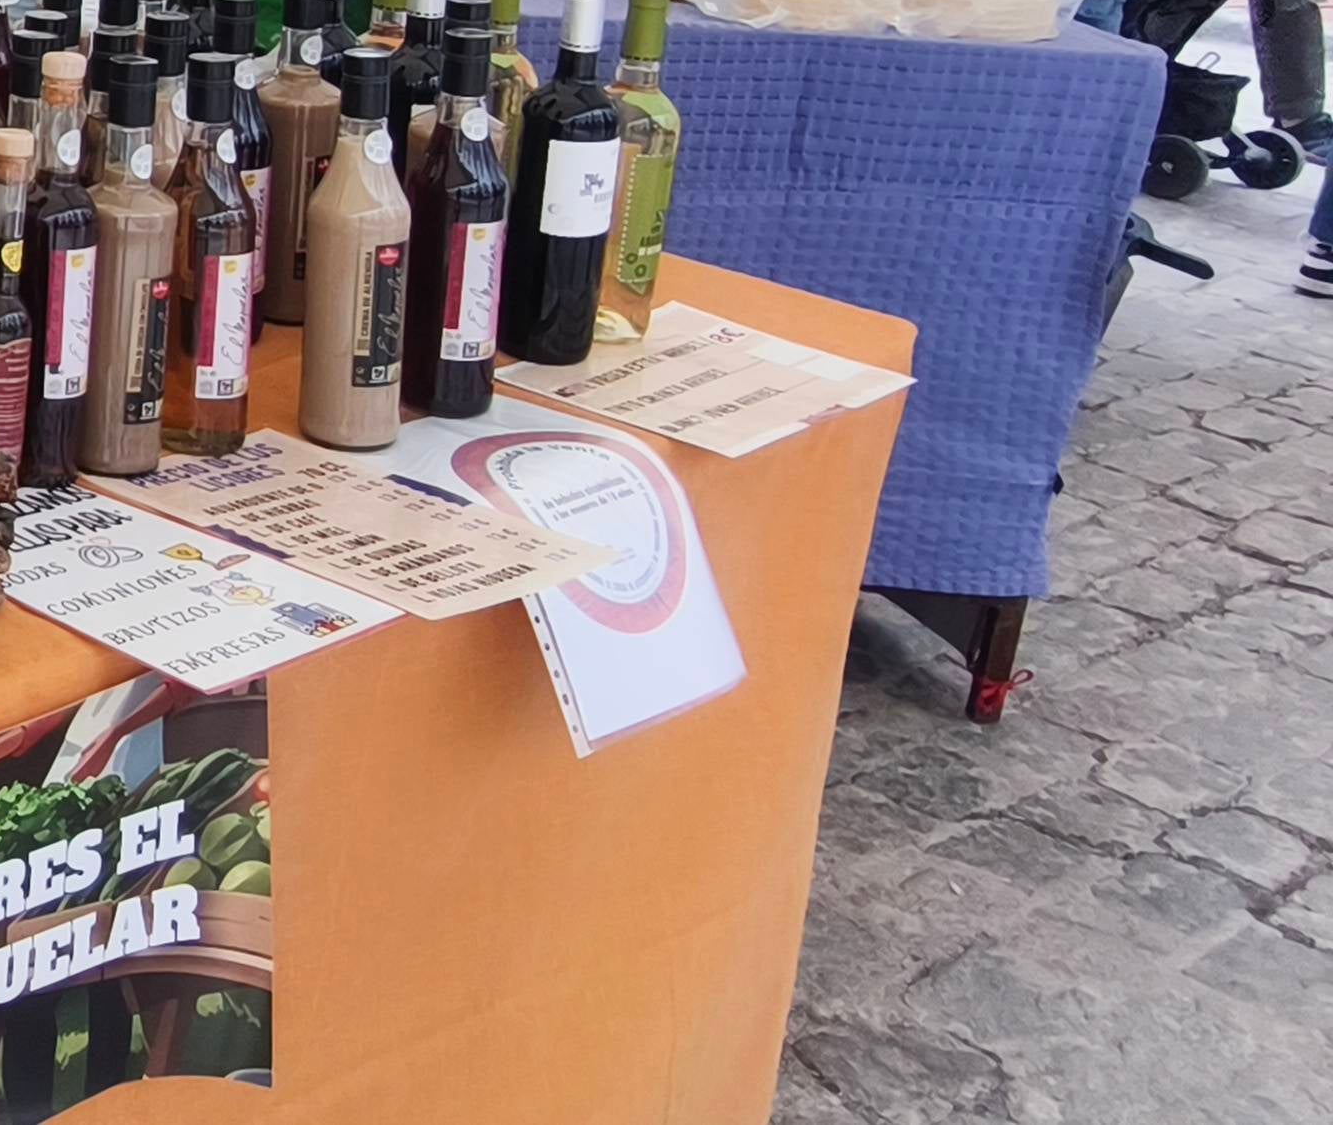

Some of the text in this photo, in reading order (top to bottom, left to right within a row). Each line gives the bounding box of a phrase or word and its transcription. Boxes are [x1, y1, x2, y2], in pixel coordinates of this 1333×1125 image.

[190, 464, 285, 492] LICORES
[47, 564, 197, 616] COMUNIONES
[103, 602, 221, 645] BAUTIZOS
[163, 626, 286, 675] EMPRESAS
[117, 800, 195, 875] EL
